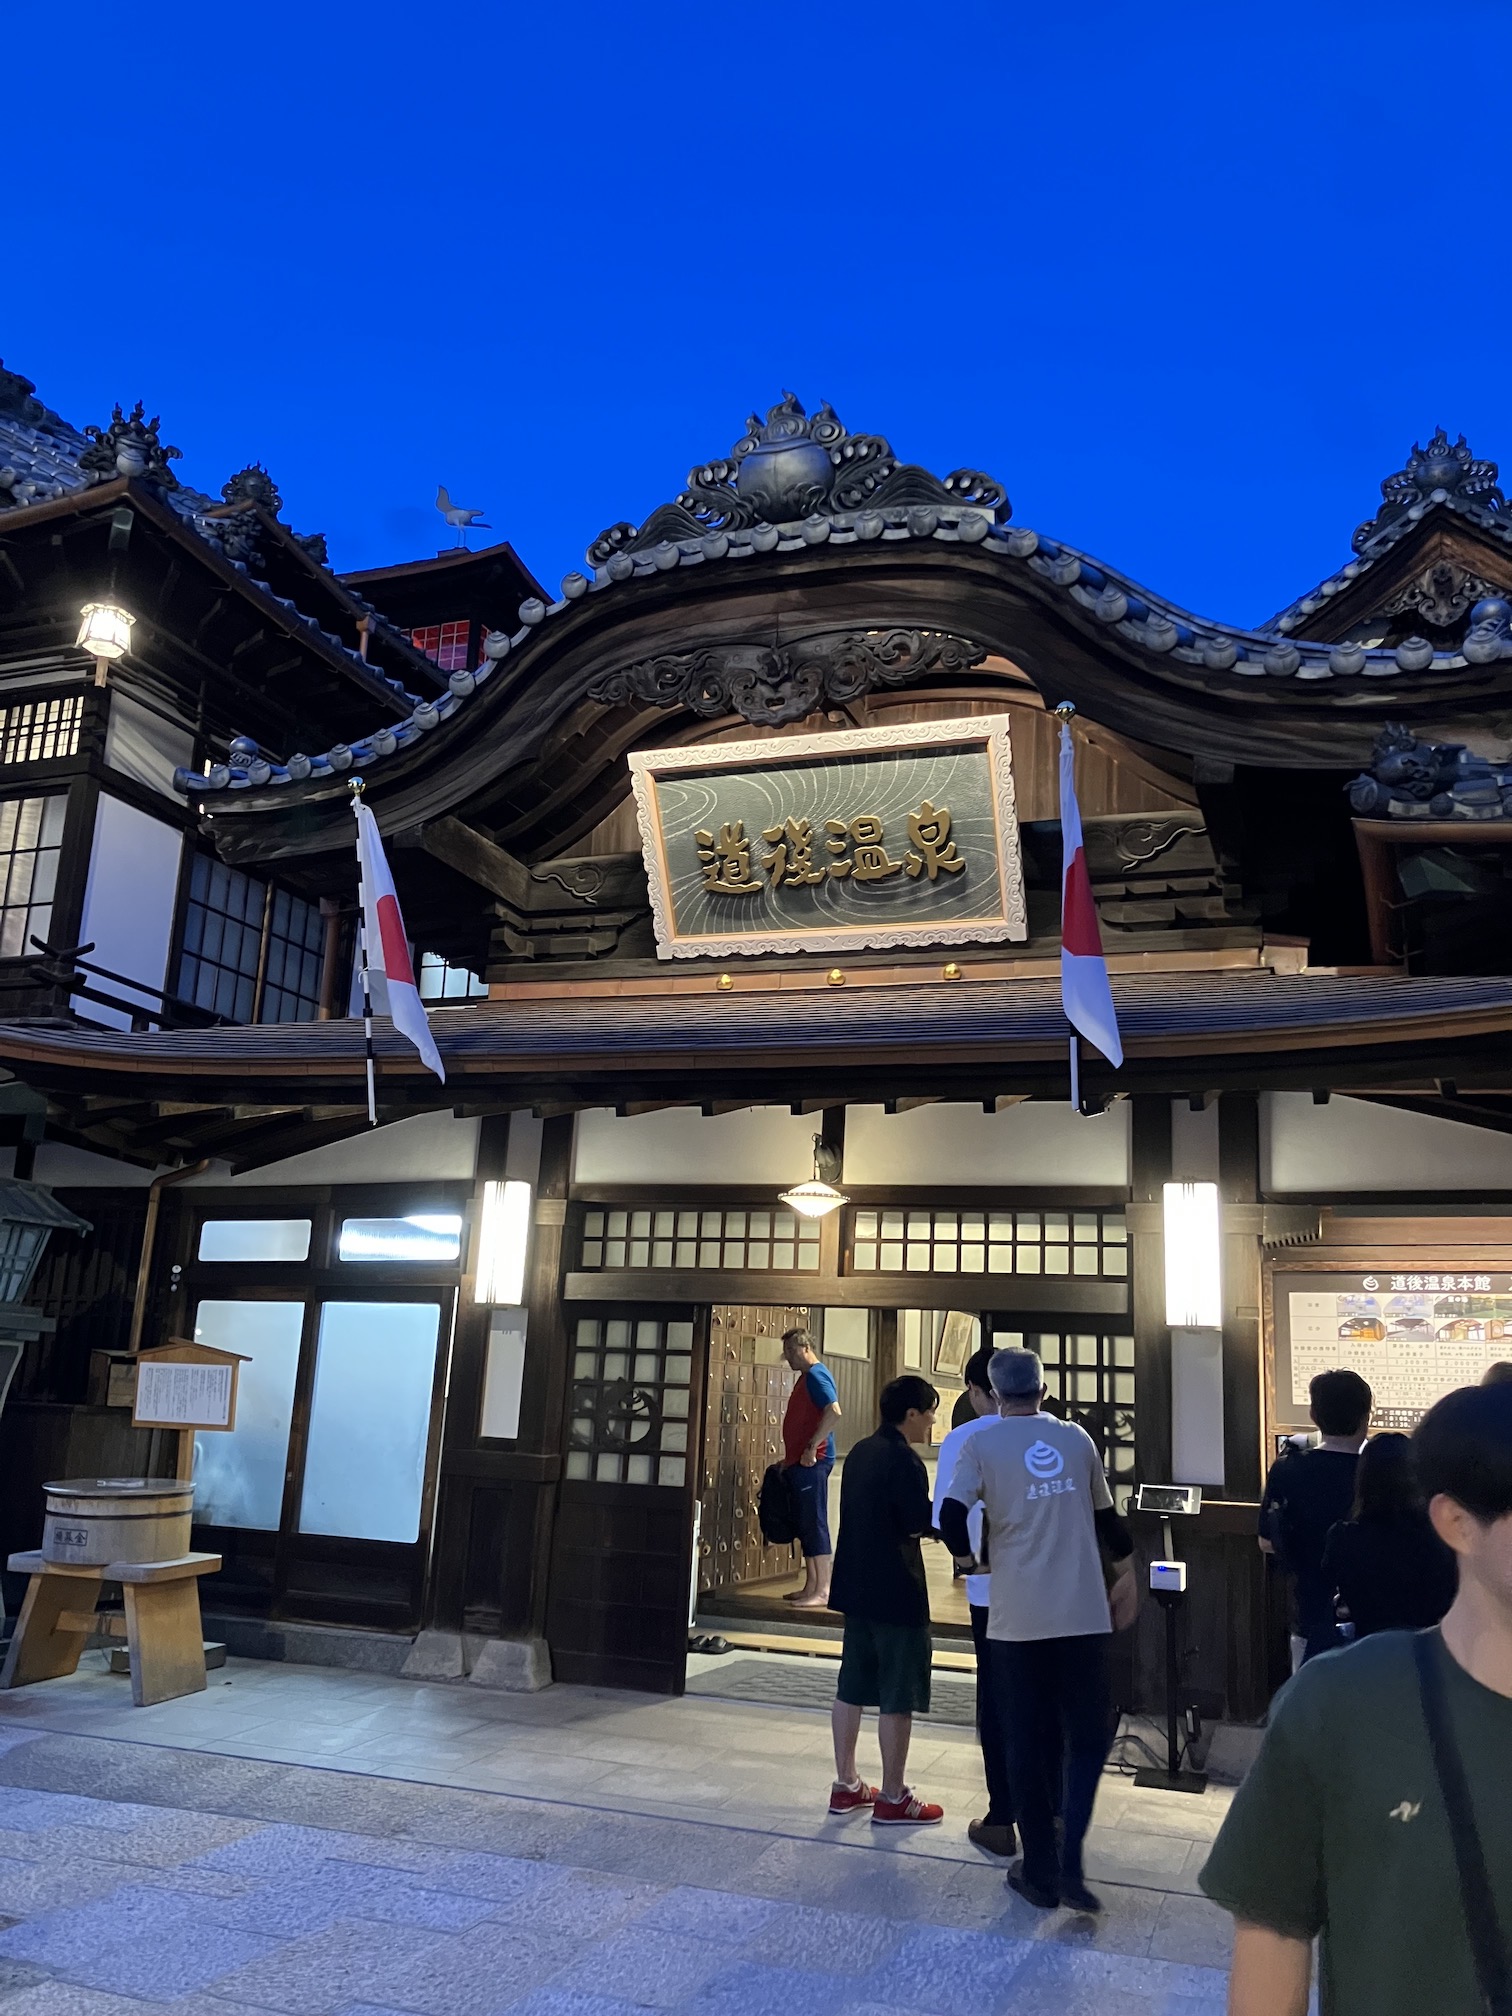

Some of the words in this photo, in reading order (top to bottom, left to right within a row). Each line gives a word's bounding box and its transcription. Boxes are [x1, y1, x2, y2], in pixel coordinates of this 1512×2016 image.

[694, 798, 966, 895] 道後温泉
[1390, 1275, 1491, 1291] 道後温泉本館
[905, 1799, 922, 1819] N
